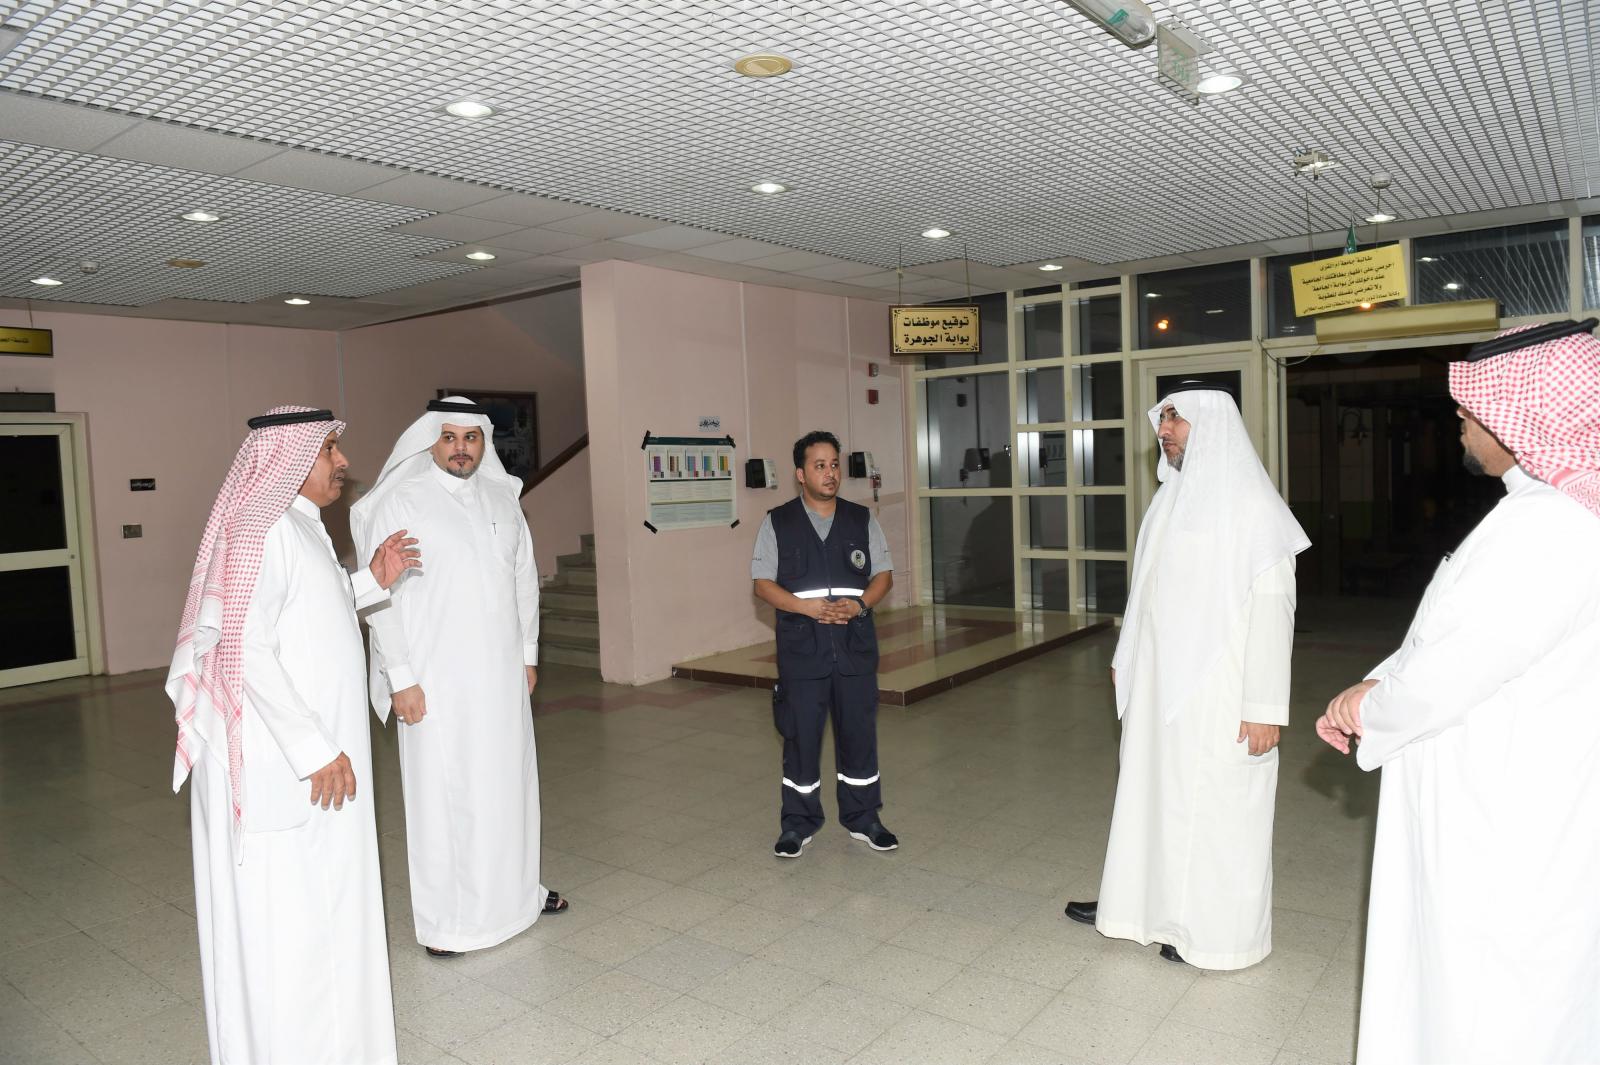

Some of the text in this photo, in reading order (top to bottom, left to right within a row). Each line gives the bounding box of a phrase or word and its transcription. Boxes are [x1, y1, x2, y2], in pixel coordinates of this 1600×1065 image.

[1313, 283, 1333, 292] الجامعة
[903, 316, 970, 330] توقيع موظفات
[904, 332, 970, 346] بوابة الجوهرة
